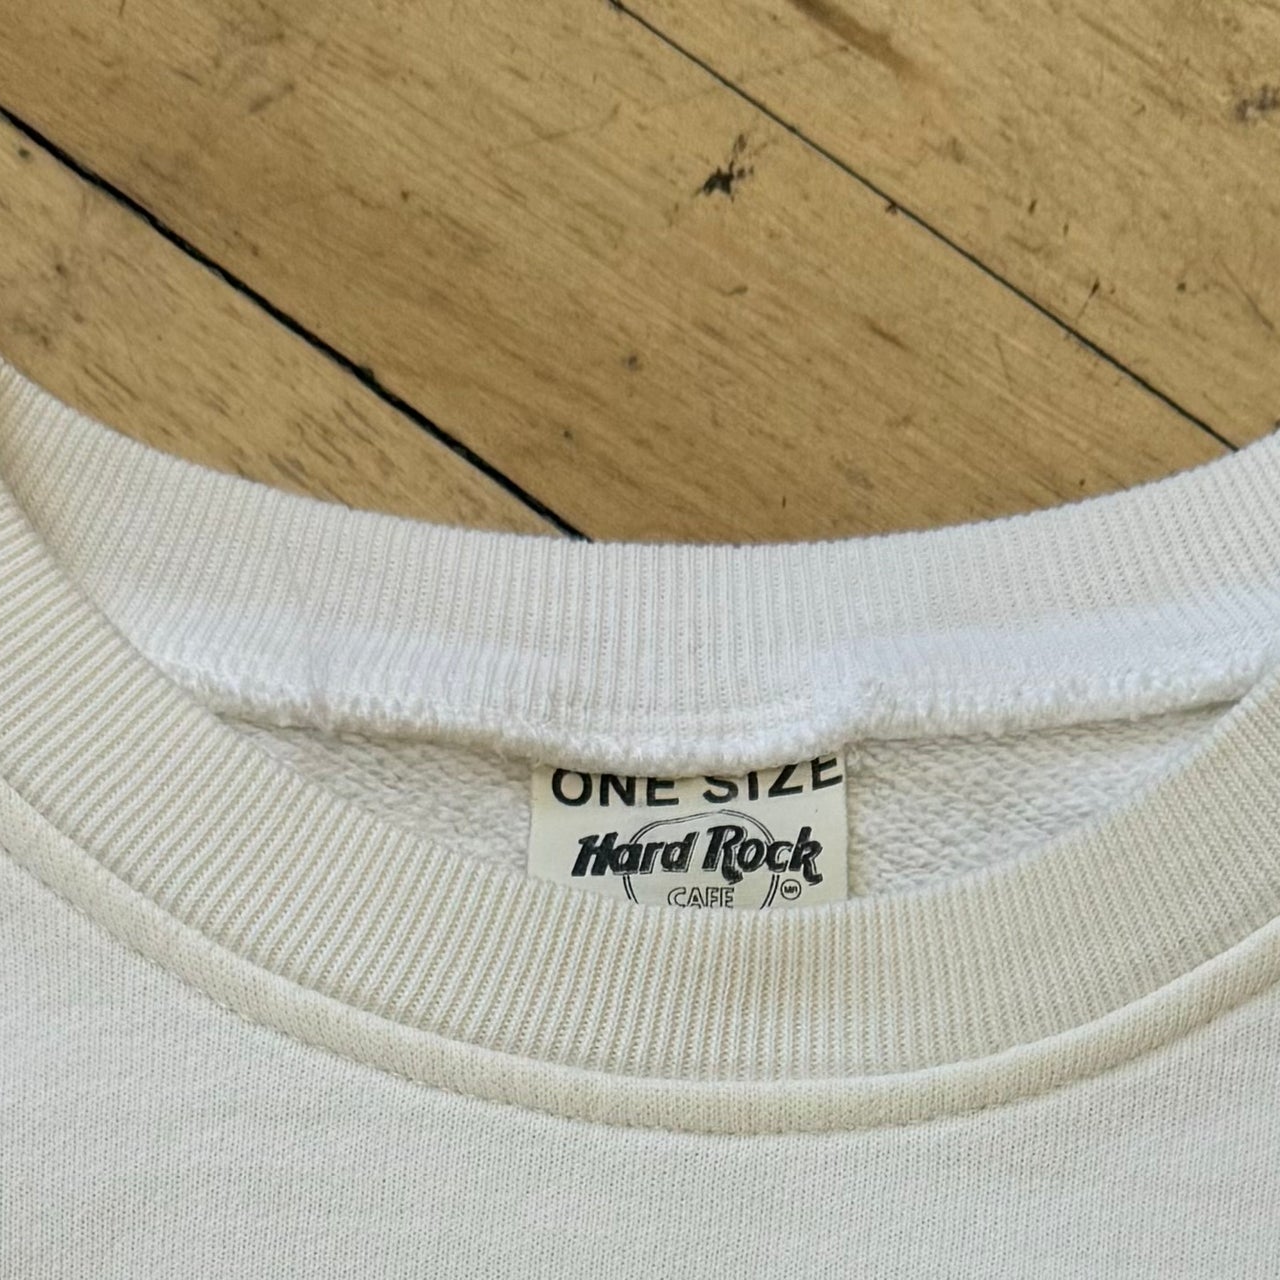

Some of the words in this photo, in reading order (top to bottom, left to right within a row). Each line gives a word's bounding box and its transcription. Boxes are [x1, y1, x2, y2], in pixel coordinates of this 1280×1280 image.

[551, 768, 679, 806] ONE
[702, 755, 843, 802] SIZE
[571, 831, 700, 876] Hard
[702, 825, 823, 885] Rock
[667, 886, 734, 909] CAFE
